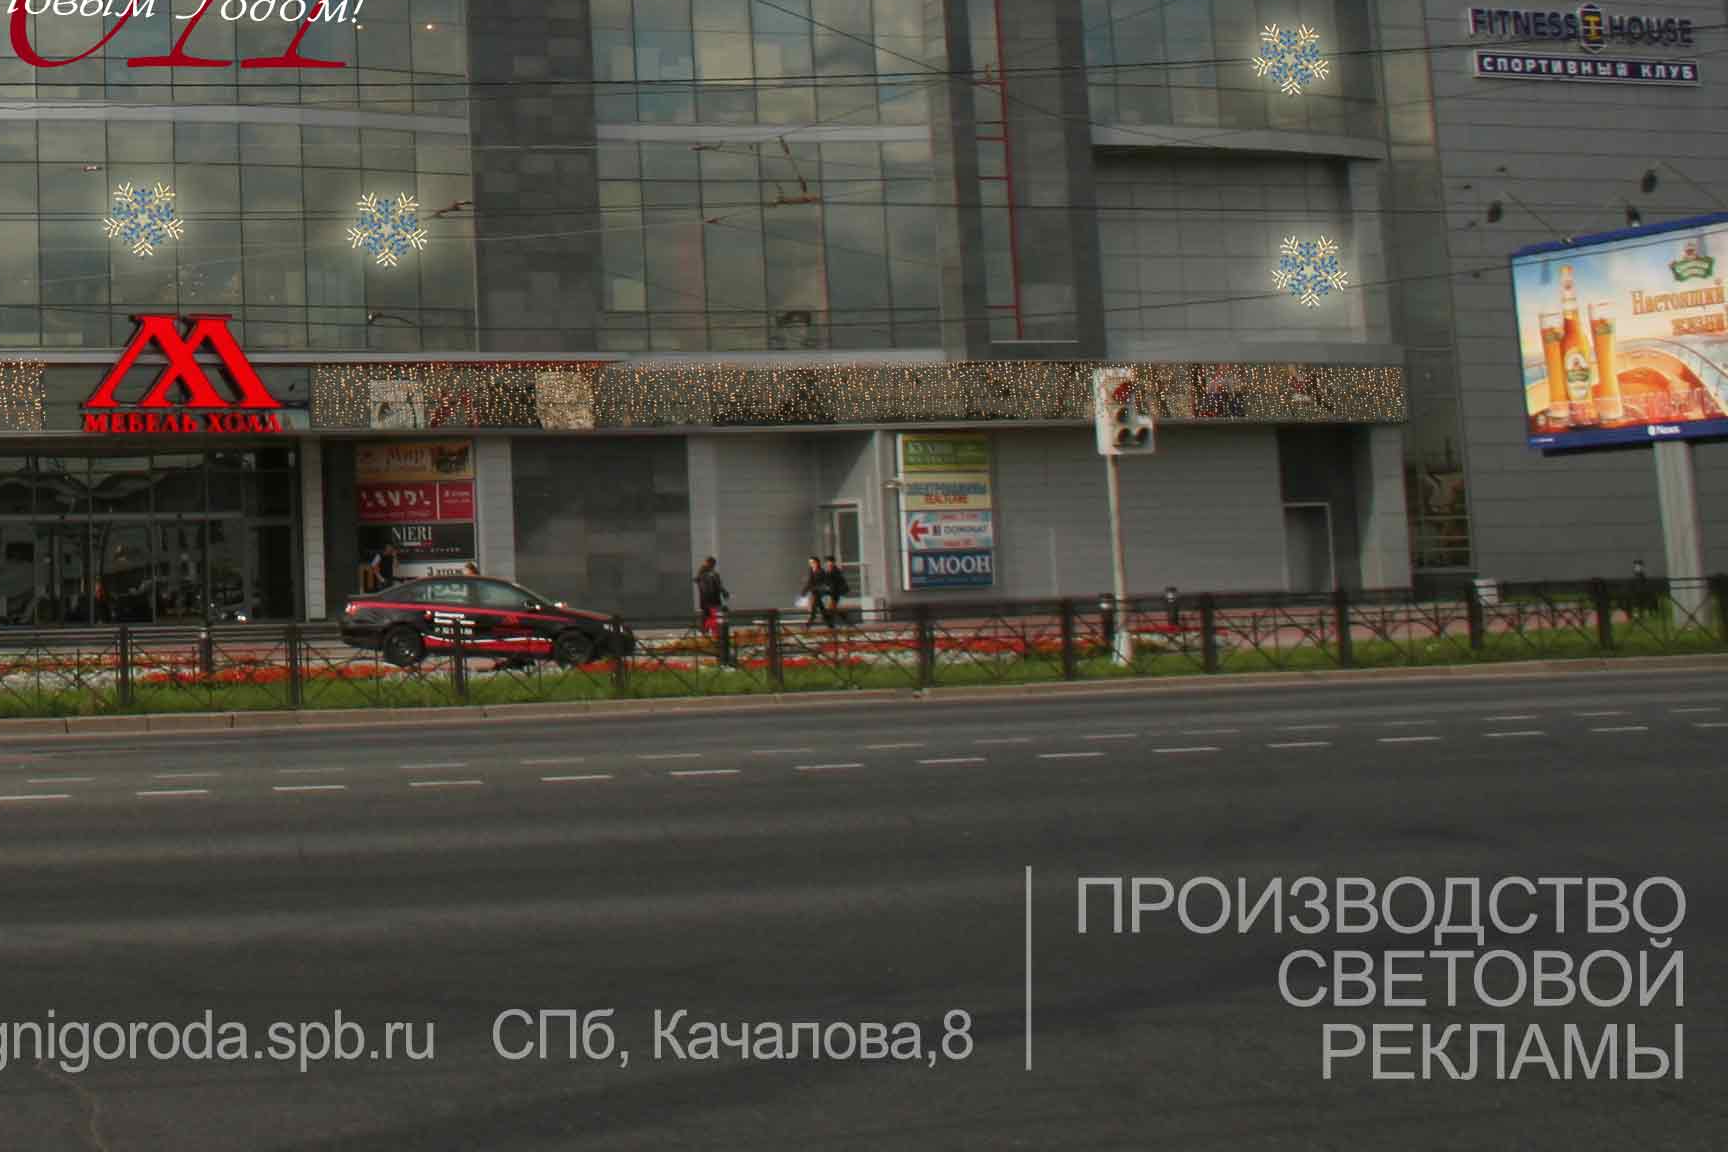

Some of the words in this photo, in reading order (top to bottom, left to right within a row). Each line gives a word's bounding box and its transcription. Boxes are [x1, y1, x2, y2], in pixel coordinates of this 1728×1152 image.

[1469, 8, 1578, 41] FITNESS
[1607, 15, 1695, 45] HOUSE
[1482, 56, 1629, 77] СПОРТИВНЫЙ
[1641, 63, 1695, 80] КЛУБ
[82, 412, 199, 432] МЕБЕЛЬ
[207, 412, 284, 432] ХОЛЛ
